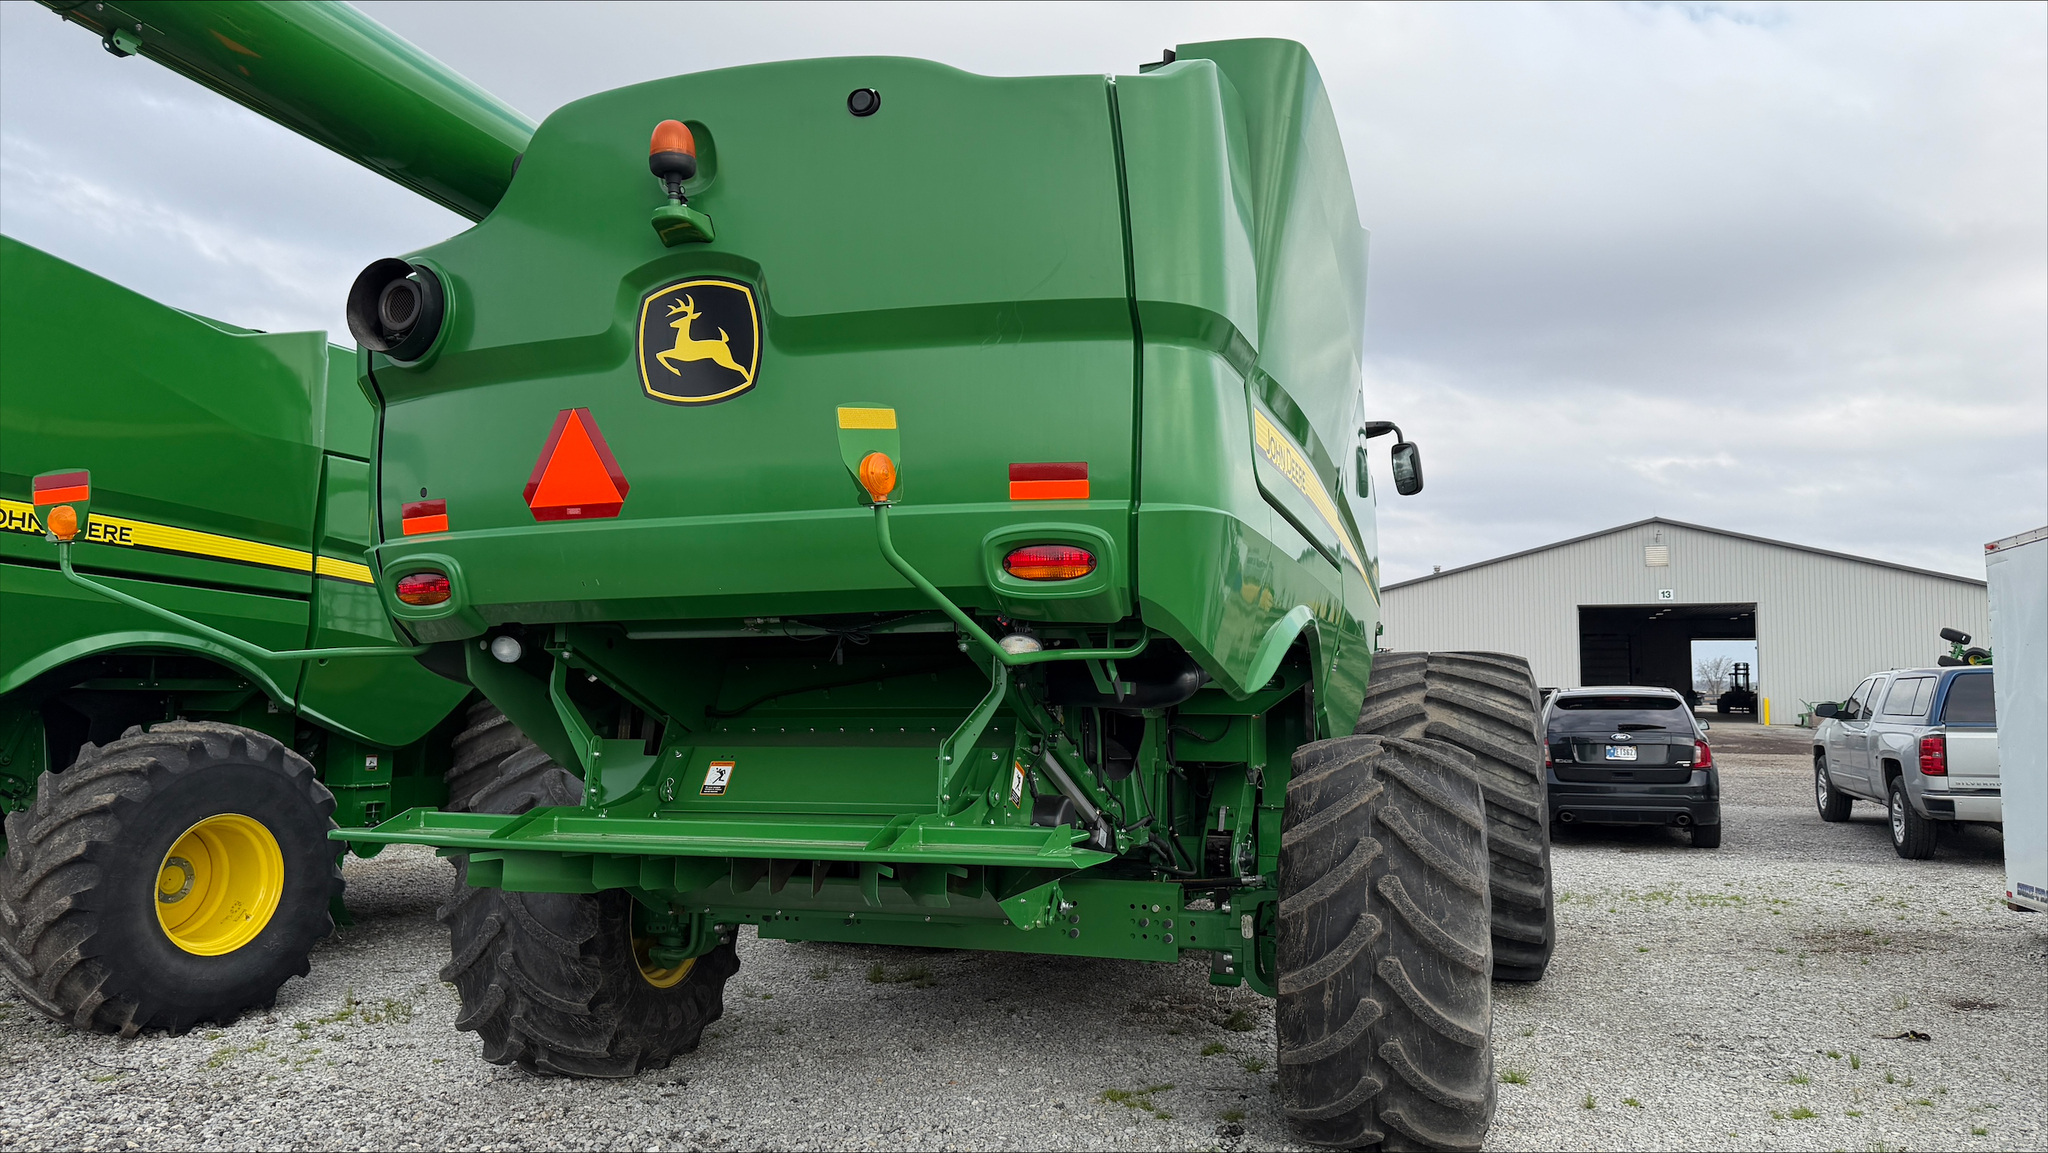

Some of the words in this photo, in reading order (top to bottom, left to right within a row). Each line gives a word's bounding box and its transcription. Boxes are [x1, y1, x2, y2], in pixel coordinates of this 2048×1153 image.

[1266, 428, 1285, 471] JOHN
[1286, 448, 1306, 491] DEERE
[0, 508, 45, 532] OHN
[88, 522, 133, 543] ERE
[1661, 590, 1671, 598] 13
